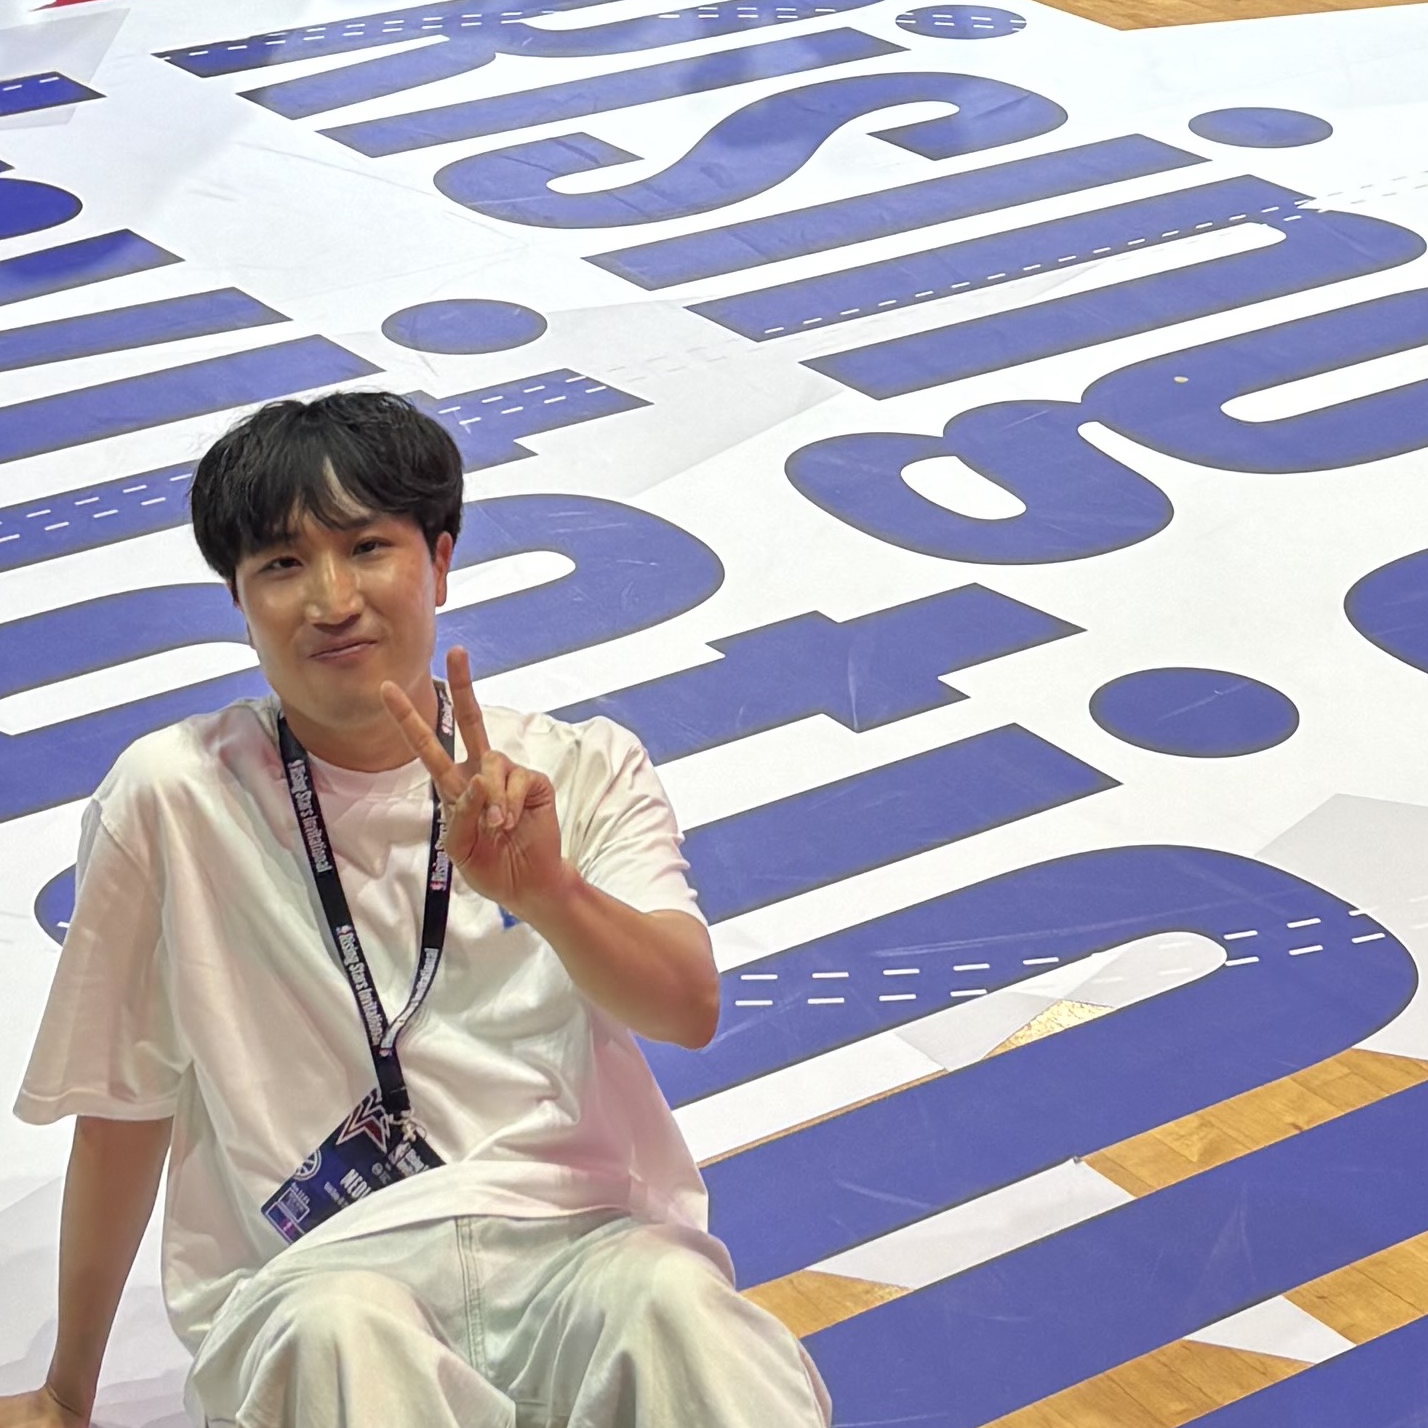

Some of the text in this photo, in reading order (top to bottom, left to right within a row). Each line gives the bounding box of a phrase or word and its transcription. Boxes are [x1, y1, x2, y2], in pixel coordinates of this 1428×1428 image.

[295, 790, 314, 817] Stars
[339, 932, 360, 966] Rising
[349, 962, 369, 990] Stars
[339, 1168, 373, 1200] MEDI
